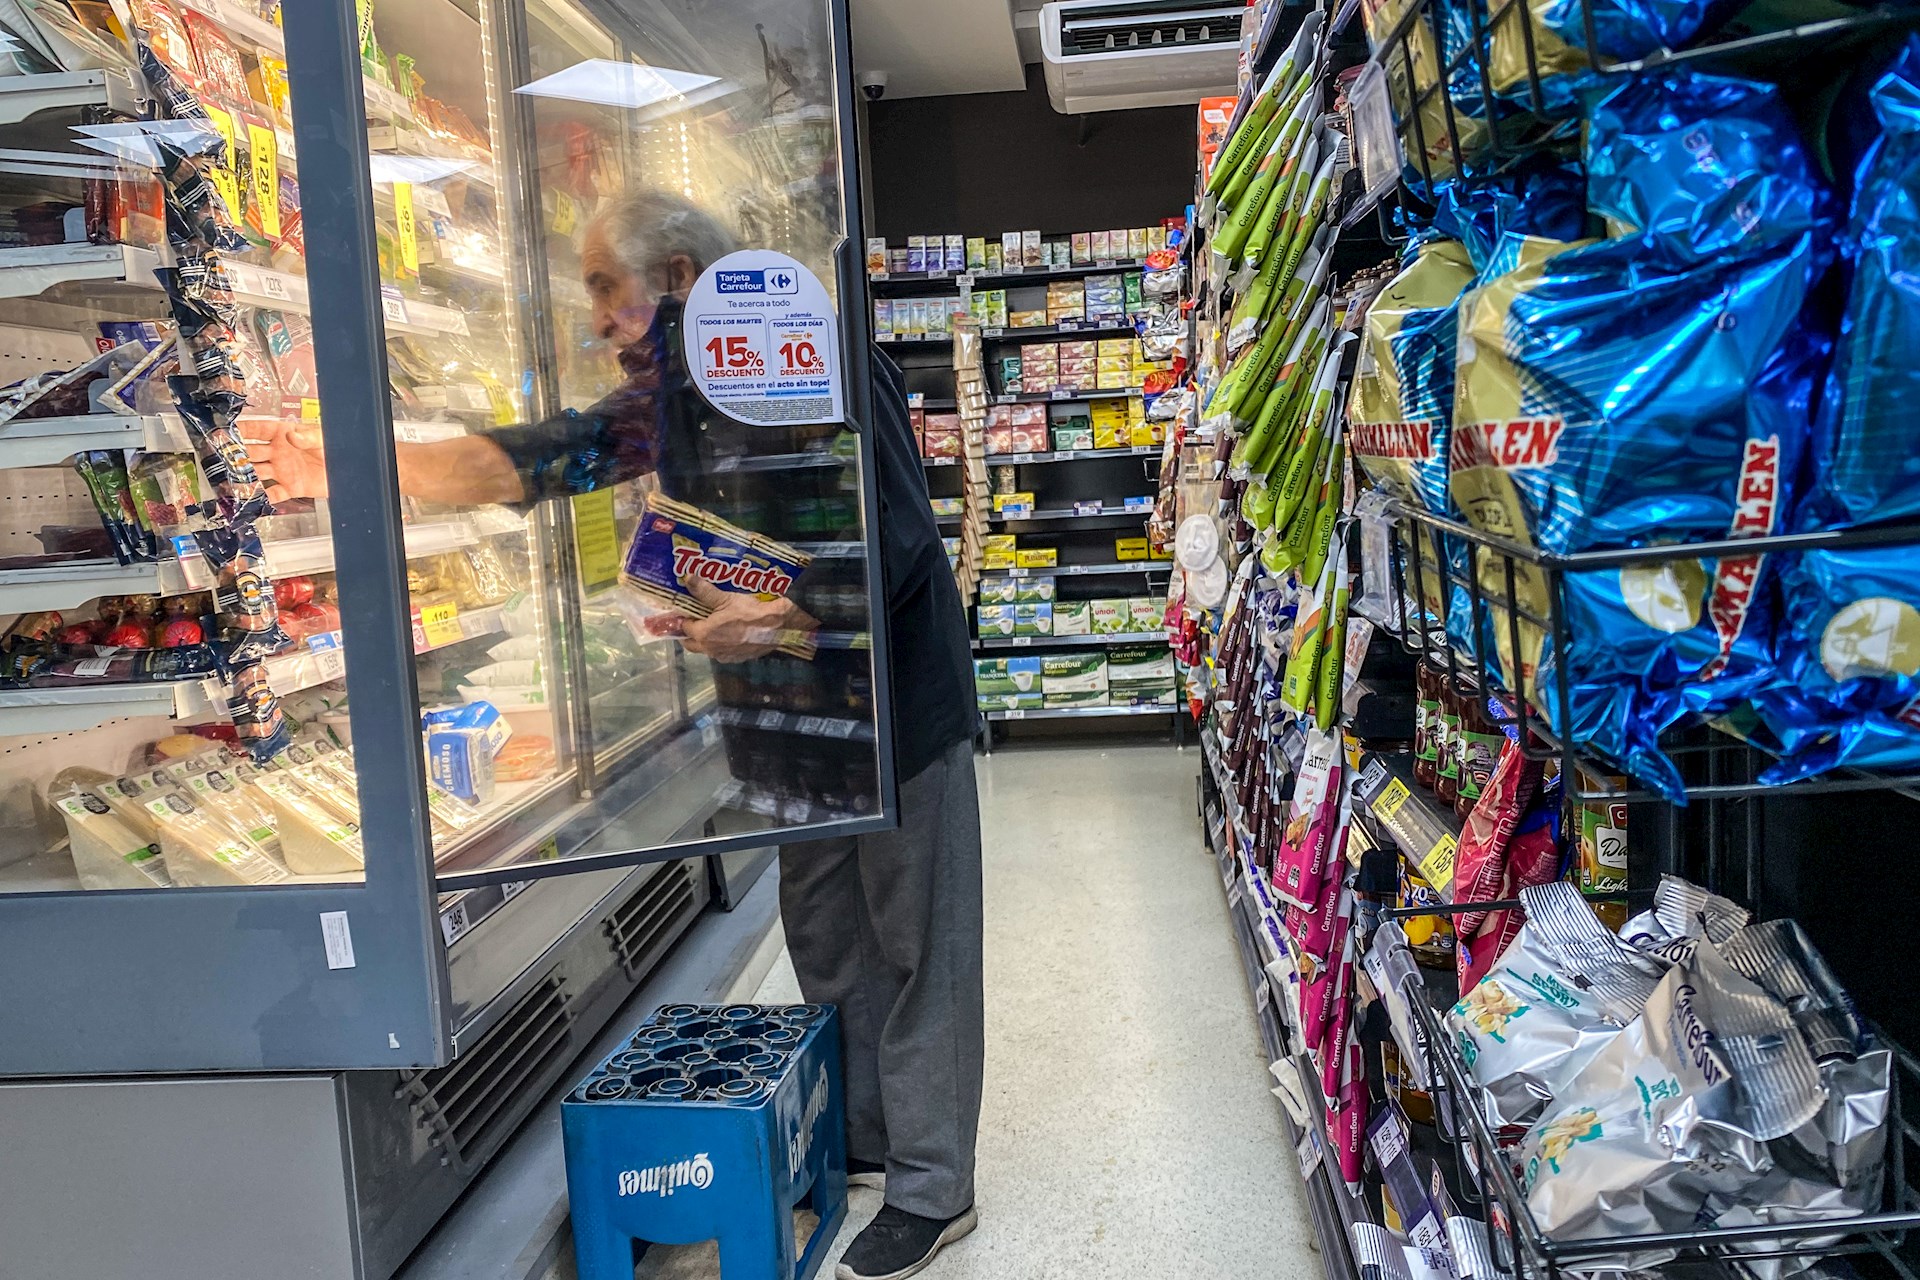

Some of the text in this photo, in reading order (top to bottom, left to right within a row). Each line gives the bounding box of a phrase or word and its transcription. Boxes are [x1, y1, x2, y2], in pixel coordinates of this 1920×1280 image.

[1227, 124, 1254, 164] Carrefour
[1242, 136, 1269, 175] Carrefour
[1239, 186, 1265, 227] Carrefour
[1267, 189, 1288, 232] Carrefour
[1265, 243, 1284, 287] Carrefour
[1277, 248, 1300, 292] Carrefour
[720, 282, 762, 291] Carrefour
[706, 336, 764, 367] 15%
[779, 342, 824, 368] 10%
[1239, 343, 1265, 382] Carrefour
[707, 369, 765, 378] DESCUENTO
[810, 379, 830, 387] tope!
[1258, 352, 1284, 393] Carrefour
[1263, 393, 1286, 435] Carrefour
[1267, 461, 1288, 502] Carrefour
[1284, 459, 1304, 500] Carrefour
[1289, 506, 1310, 547] Carrefour
[1318, 514, 1332, 556] Carrefour
[674, 547, 791, 595] Traviata
[1225, 623, 1236, 651] Carrefour
[1044, 661, 1081, 669] Carrefour
[1232, 653, 1241, 681] Carrefour
[1307, 640, 1322, 682] Carrefour
[1326, 658, 1338, 700] Carrefour
[1234, 724, 1245, 752] Carrefour
[442, 744, 454, 791] CREMOSO
[1243, 759, 1251, 787] Carrefour
[1252, 785, 1260, 814] Carrefour
[1310, 832, 1324, 875] Carrefour
[1322, 891, 1337, 932] Carrefour
[1319, 981, 1333, 1022] Carrefour
[1532, 973, 1580, 1008] SPORT
[1332, 1028, 1343, 1068] Carrefour
[1675, 984, 1722, 1087] Carrefour
[1350, 1111, 1358, 1152] Carrefour
[619, 1152, 714, 1197] Quilmes
